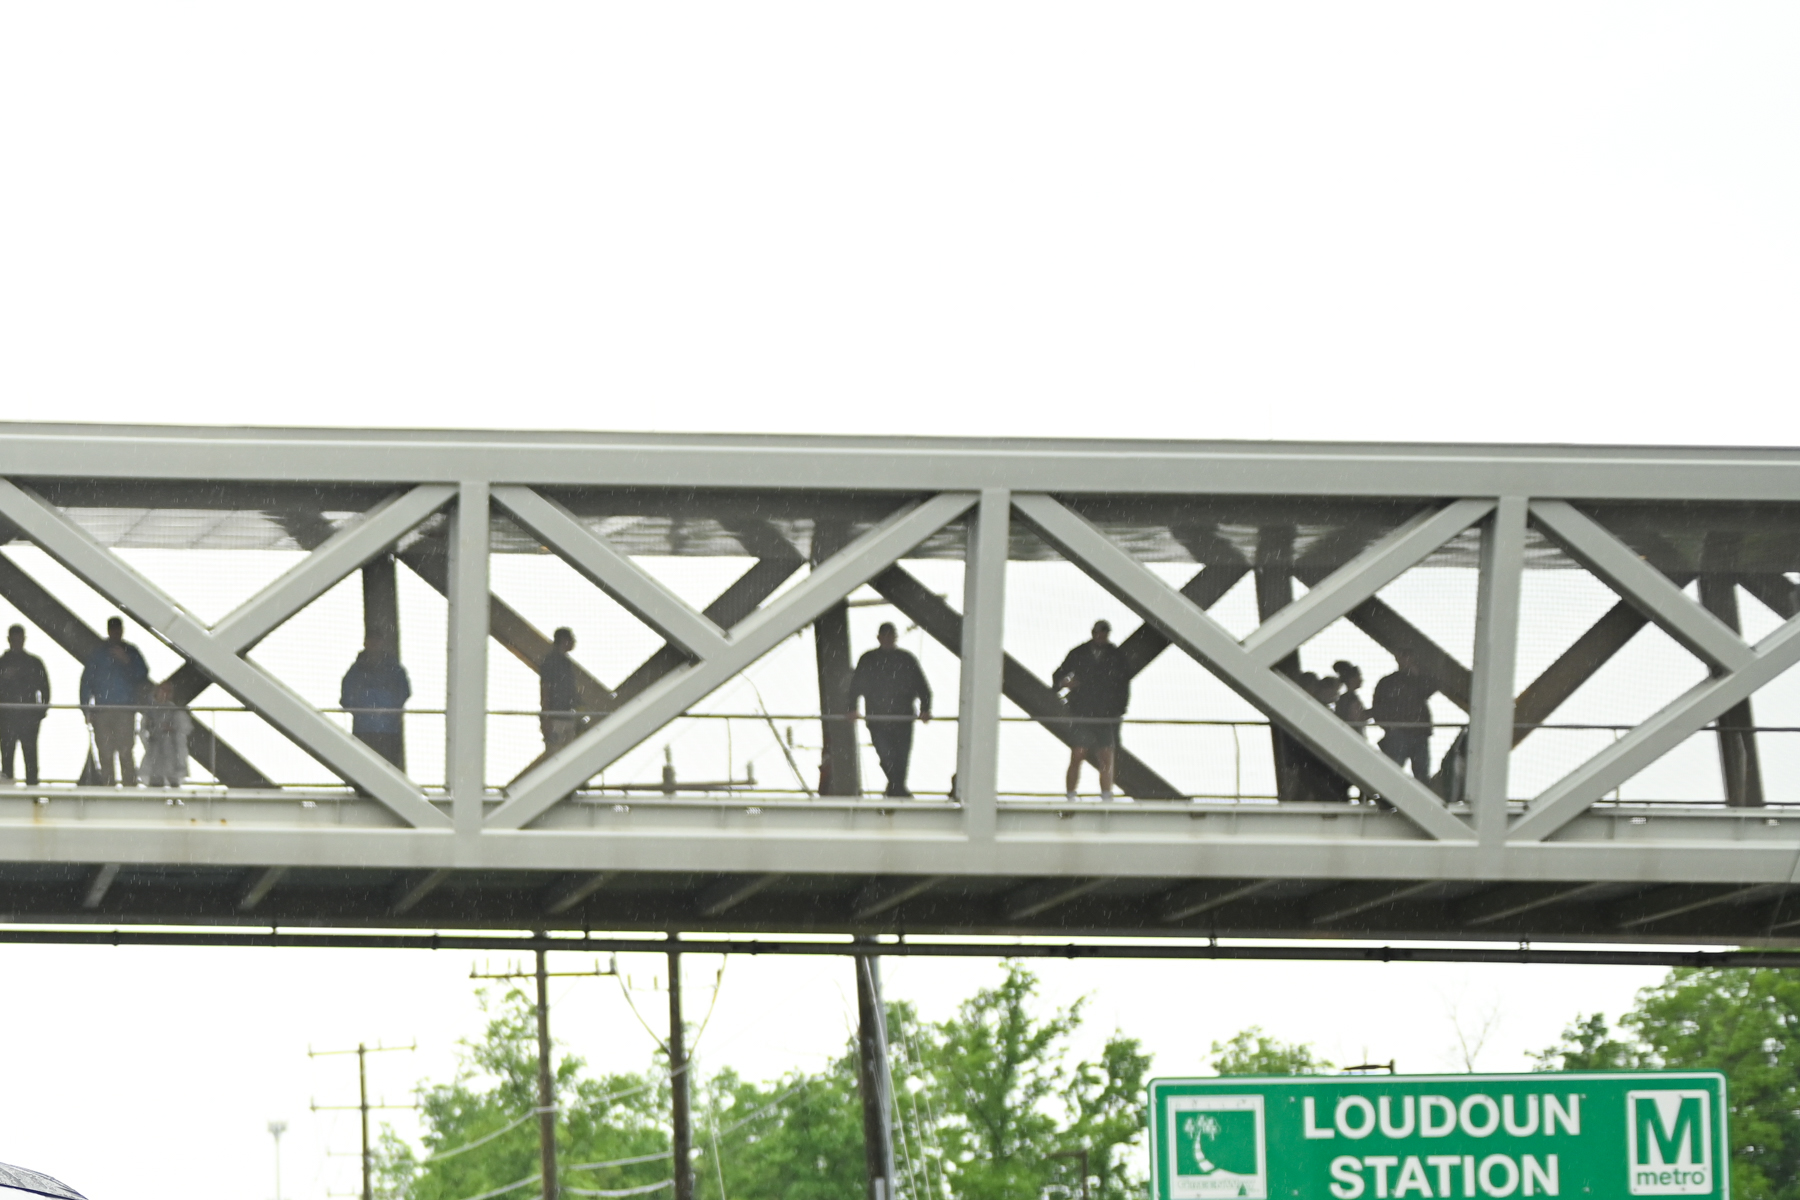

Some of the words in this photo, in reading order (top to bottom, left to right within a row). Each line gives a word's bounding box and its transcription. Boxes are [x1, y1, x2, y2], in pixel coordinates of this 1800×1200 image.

[1303, 1093, 1581, 1139] LOUDOUN
[1635, 1097, 1704, 1165] M
[1329, 1154, 1560, 1200] STATION
[1637, 1168, 1705, 1186] metro
